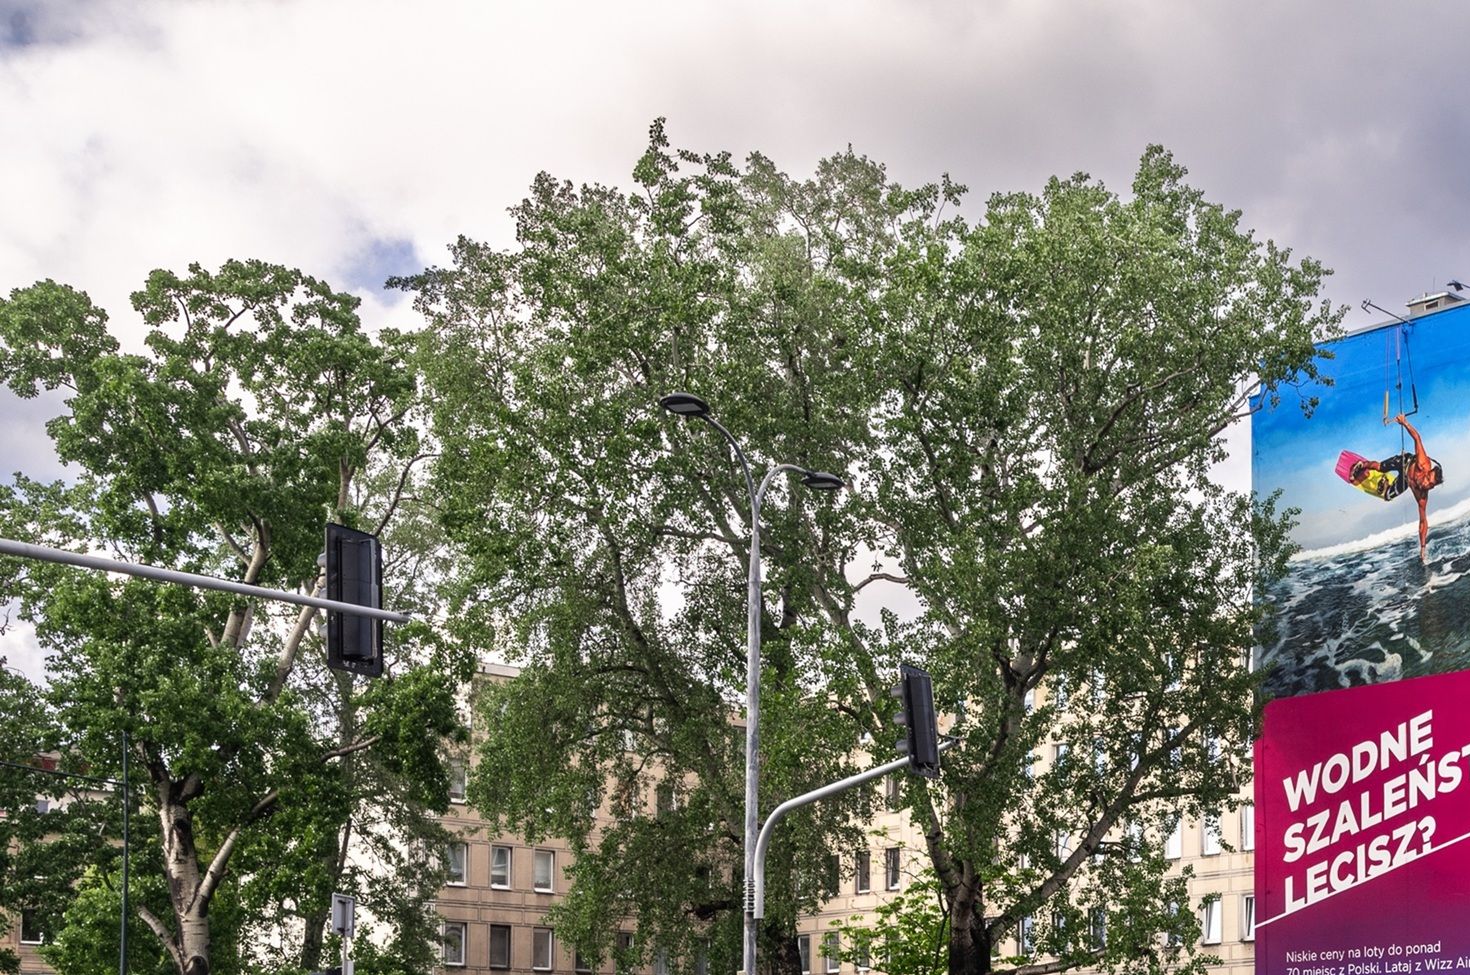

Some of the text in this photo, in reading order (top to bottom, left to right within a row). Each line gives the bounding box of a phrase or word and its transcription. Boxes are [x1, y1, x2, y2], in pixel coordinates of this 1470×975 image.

[1282, 709, 1435, 812] WODNE
[1284, 815, 1437, 914] LECISZ?
[1286, 941, 1441, 963] Niskie ceny na loty do ponad
[1339, 966, 1345, 975] z
[1348, 962, 1382, 975] Polski.
[1385, 960, 1412, 974] Lataj
[1415, 961, 1421, 971] z
[1424, 958, 1453, 970] Wizz
